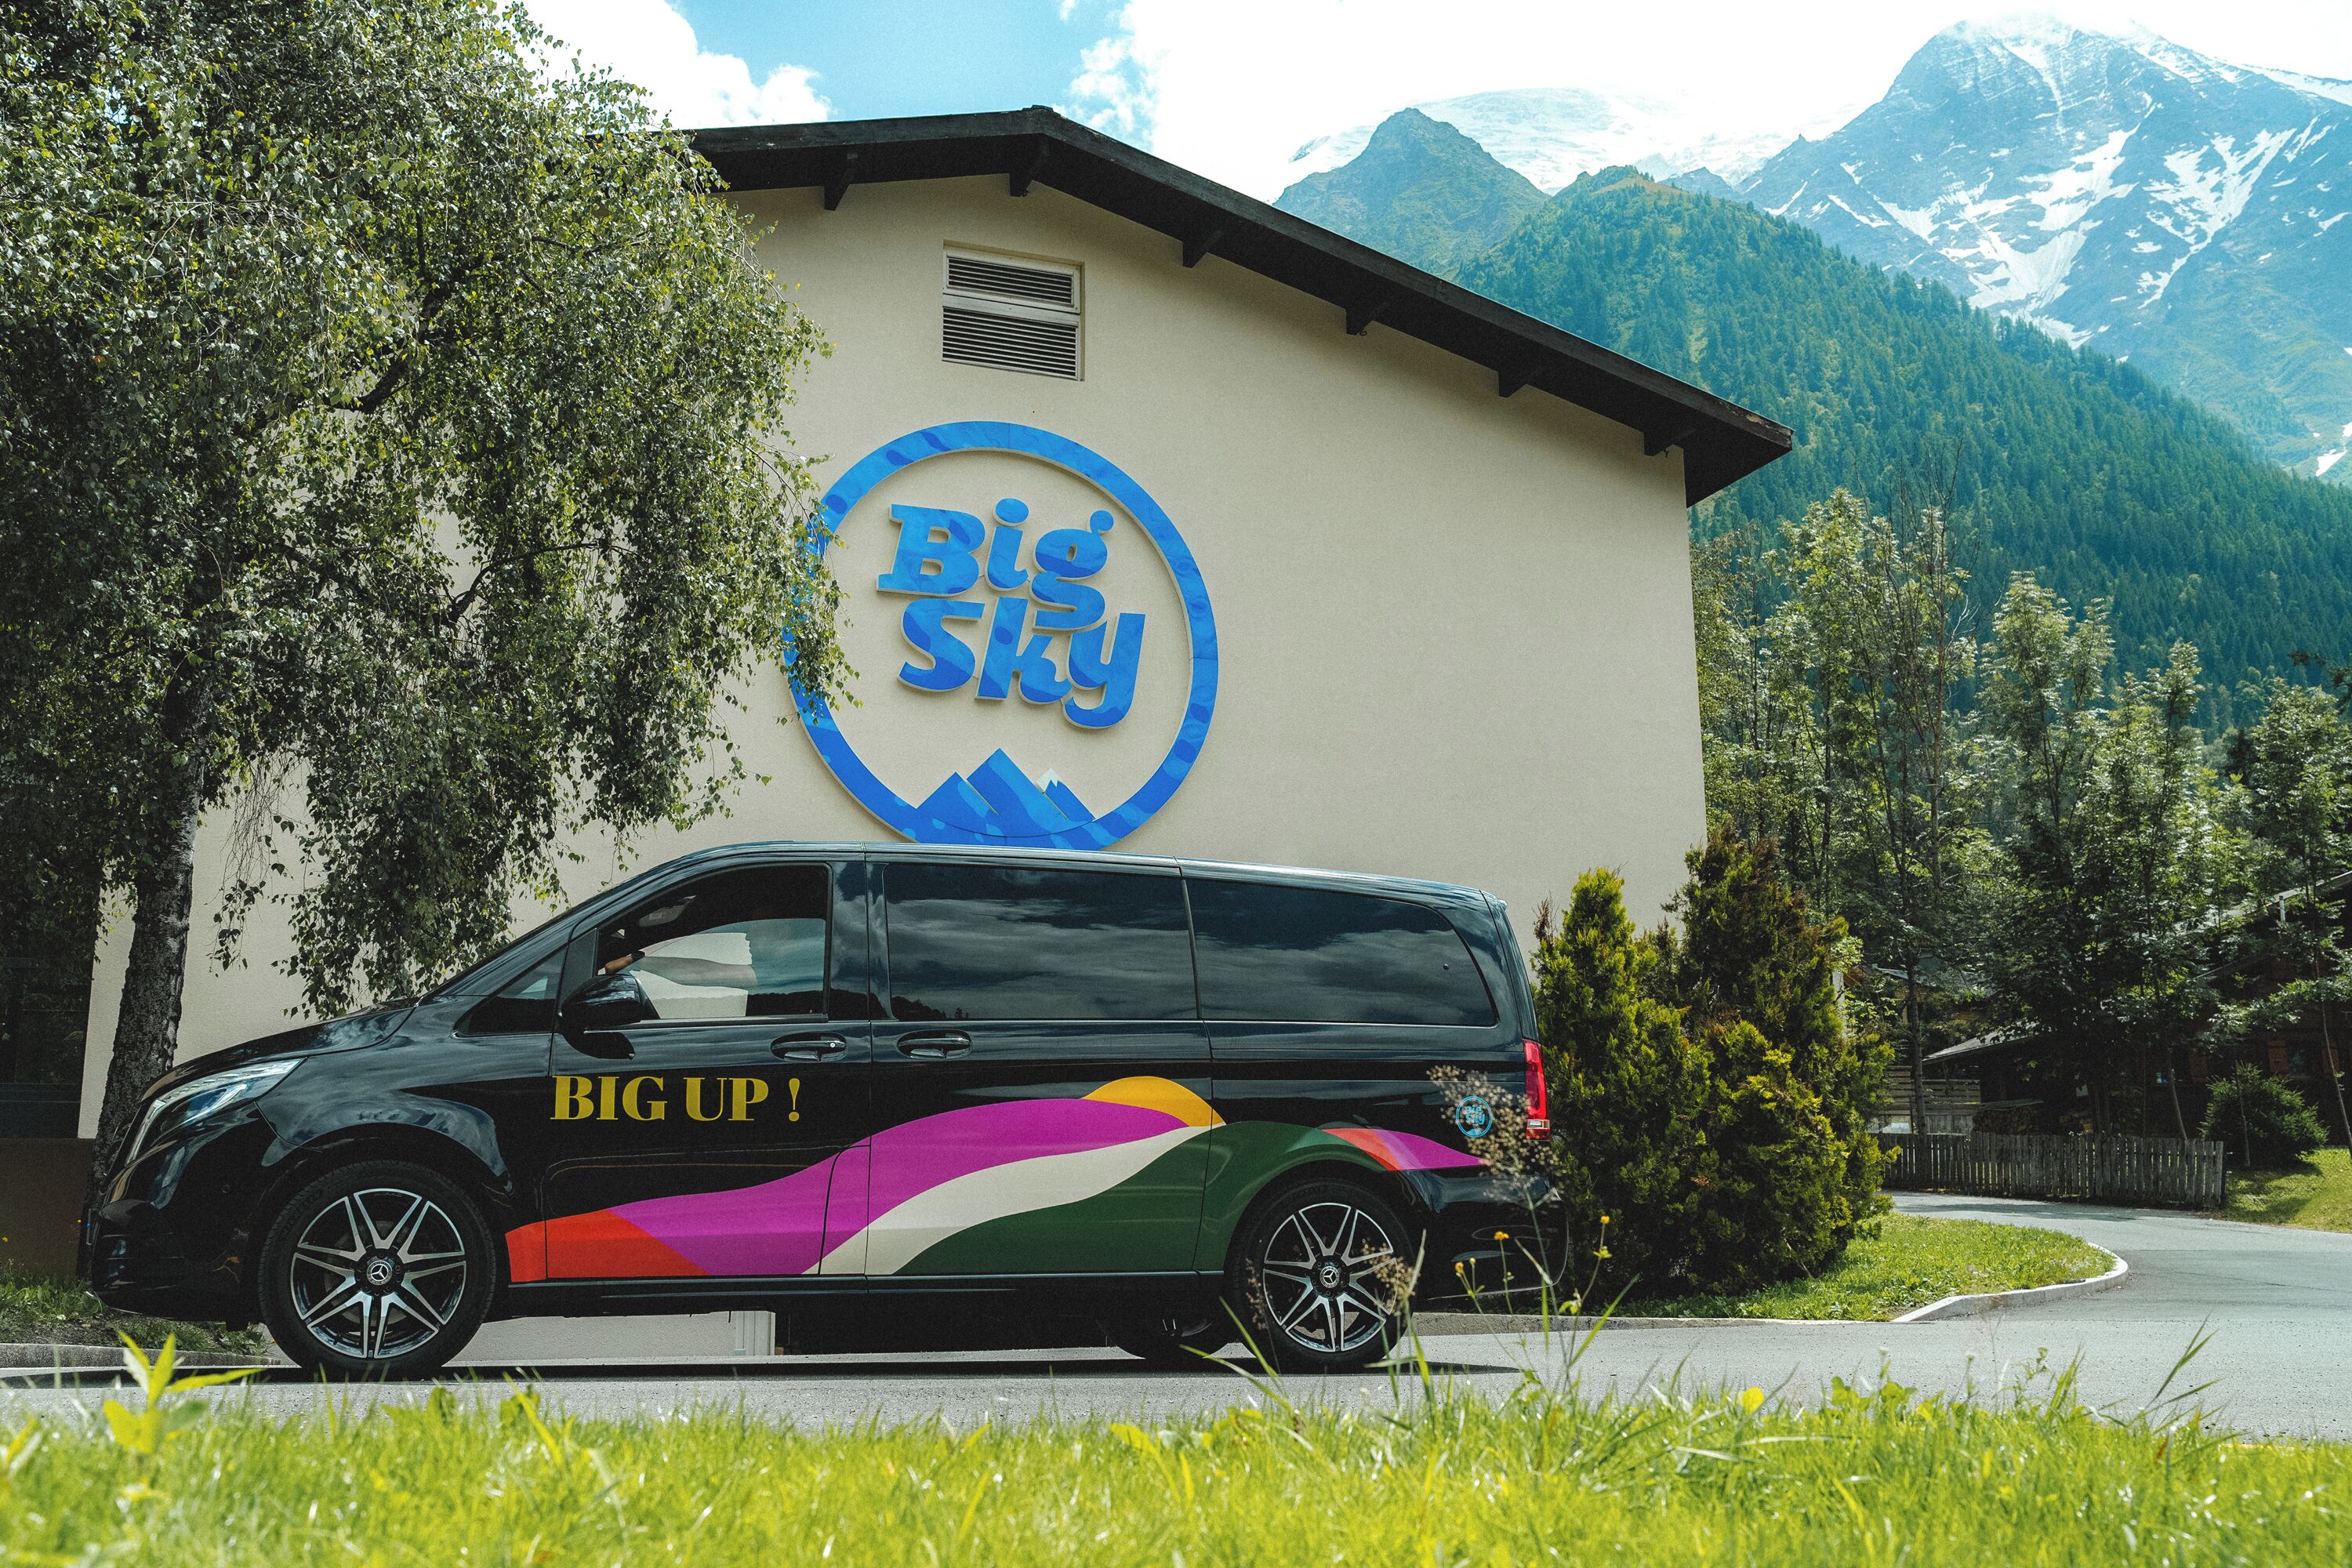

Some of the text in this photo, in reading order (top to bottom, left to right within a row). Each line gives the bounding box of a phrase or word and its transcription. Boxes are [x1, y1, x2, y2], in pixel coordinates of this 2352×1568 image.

[877, 497, 1114, 630] Big
[897, 596, 1146, 729] Sky
[550, 1075, 800, 1122] BIG UP !
